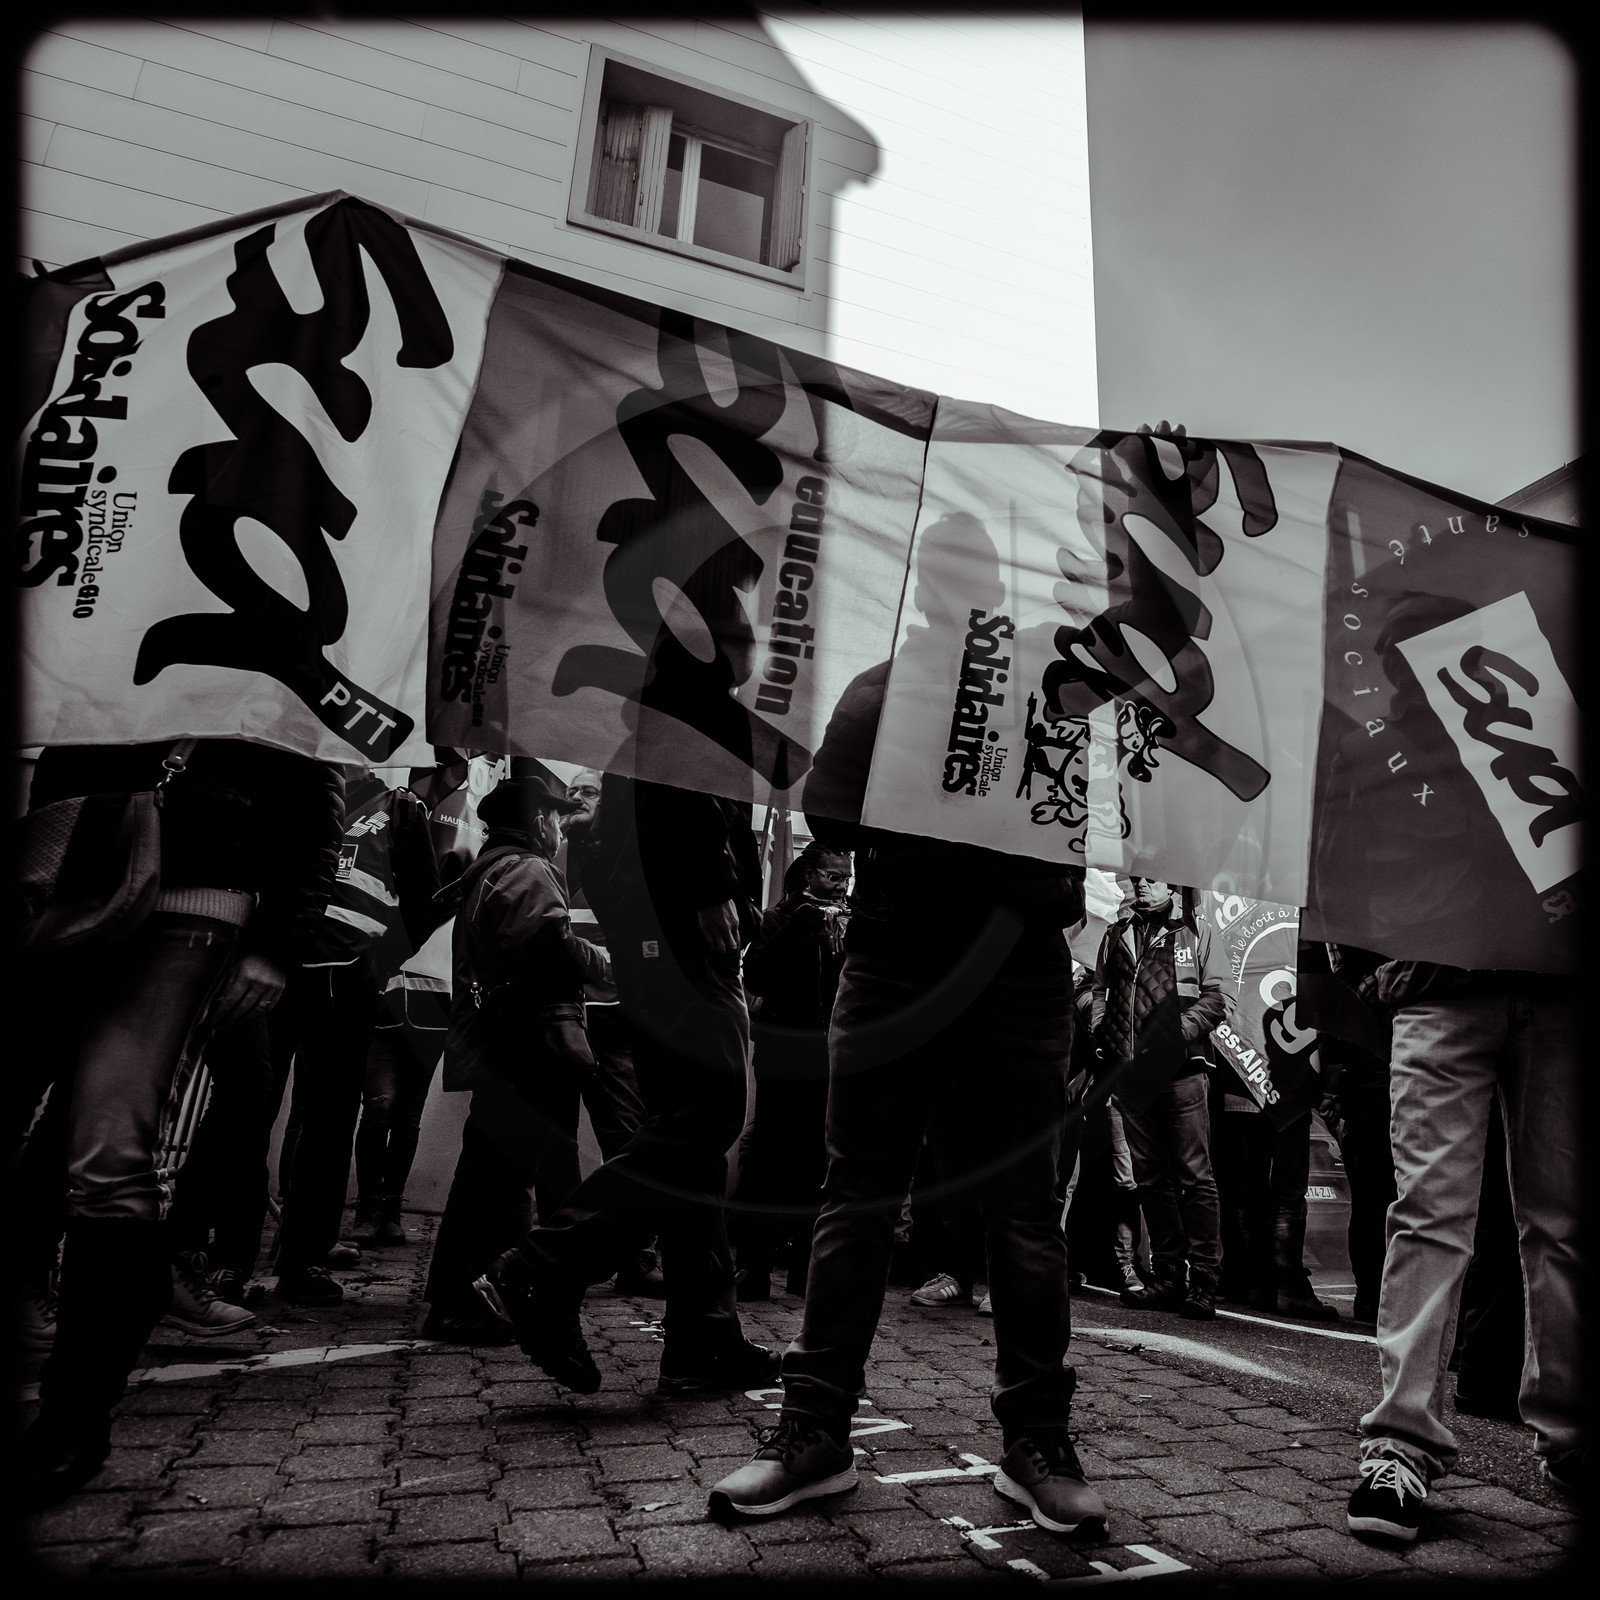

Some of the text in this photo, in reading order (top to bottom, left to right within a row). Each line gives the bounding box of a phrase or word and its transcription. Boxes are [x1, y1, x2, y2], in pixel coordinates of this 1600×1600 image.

[81, 488, 111, 586] syndicale
[106, 490, 138, 555] Union
[440, 489, 540, 704] Solidaires
[471, 640, 496, 703] syndicale
[486, 644, 511, 685] Union
[1342, 580, 1437, 808] sociaux
[319, 681, 397, 747] PTT
[941, 608, 1016, 797] Solidaires
[977, 743, 997, 798] syndicale
[990, 746, 1009, 783] Union
[337, 855, 355, 870] gt
[1241, 911, 1275, 939] droit
[1278, 907, 1290, 918] à
[1230, 937, 1247, 951] le
[1231, 951, 1246, 985] pour
[1215, 1021, 1281, 1105] es-Alpes
